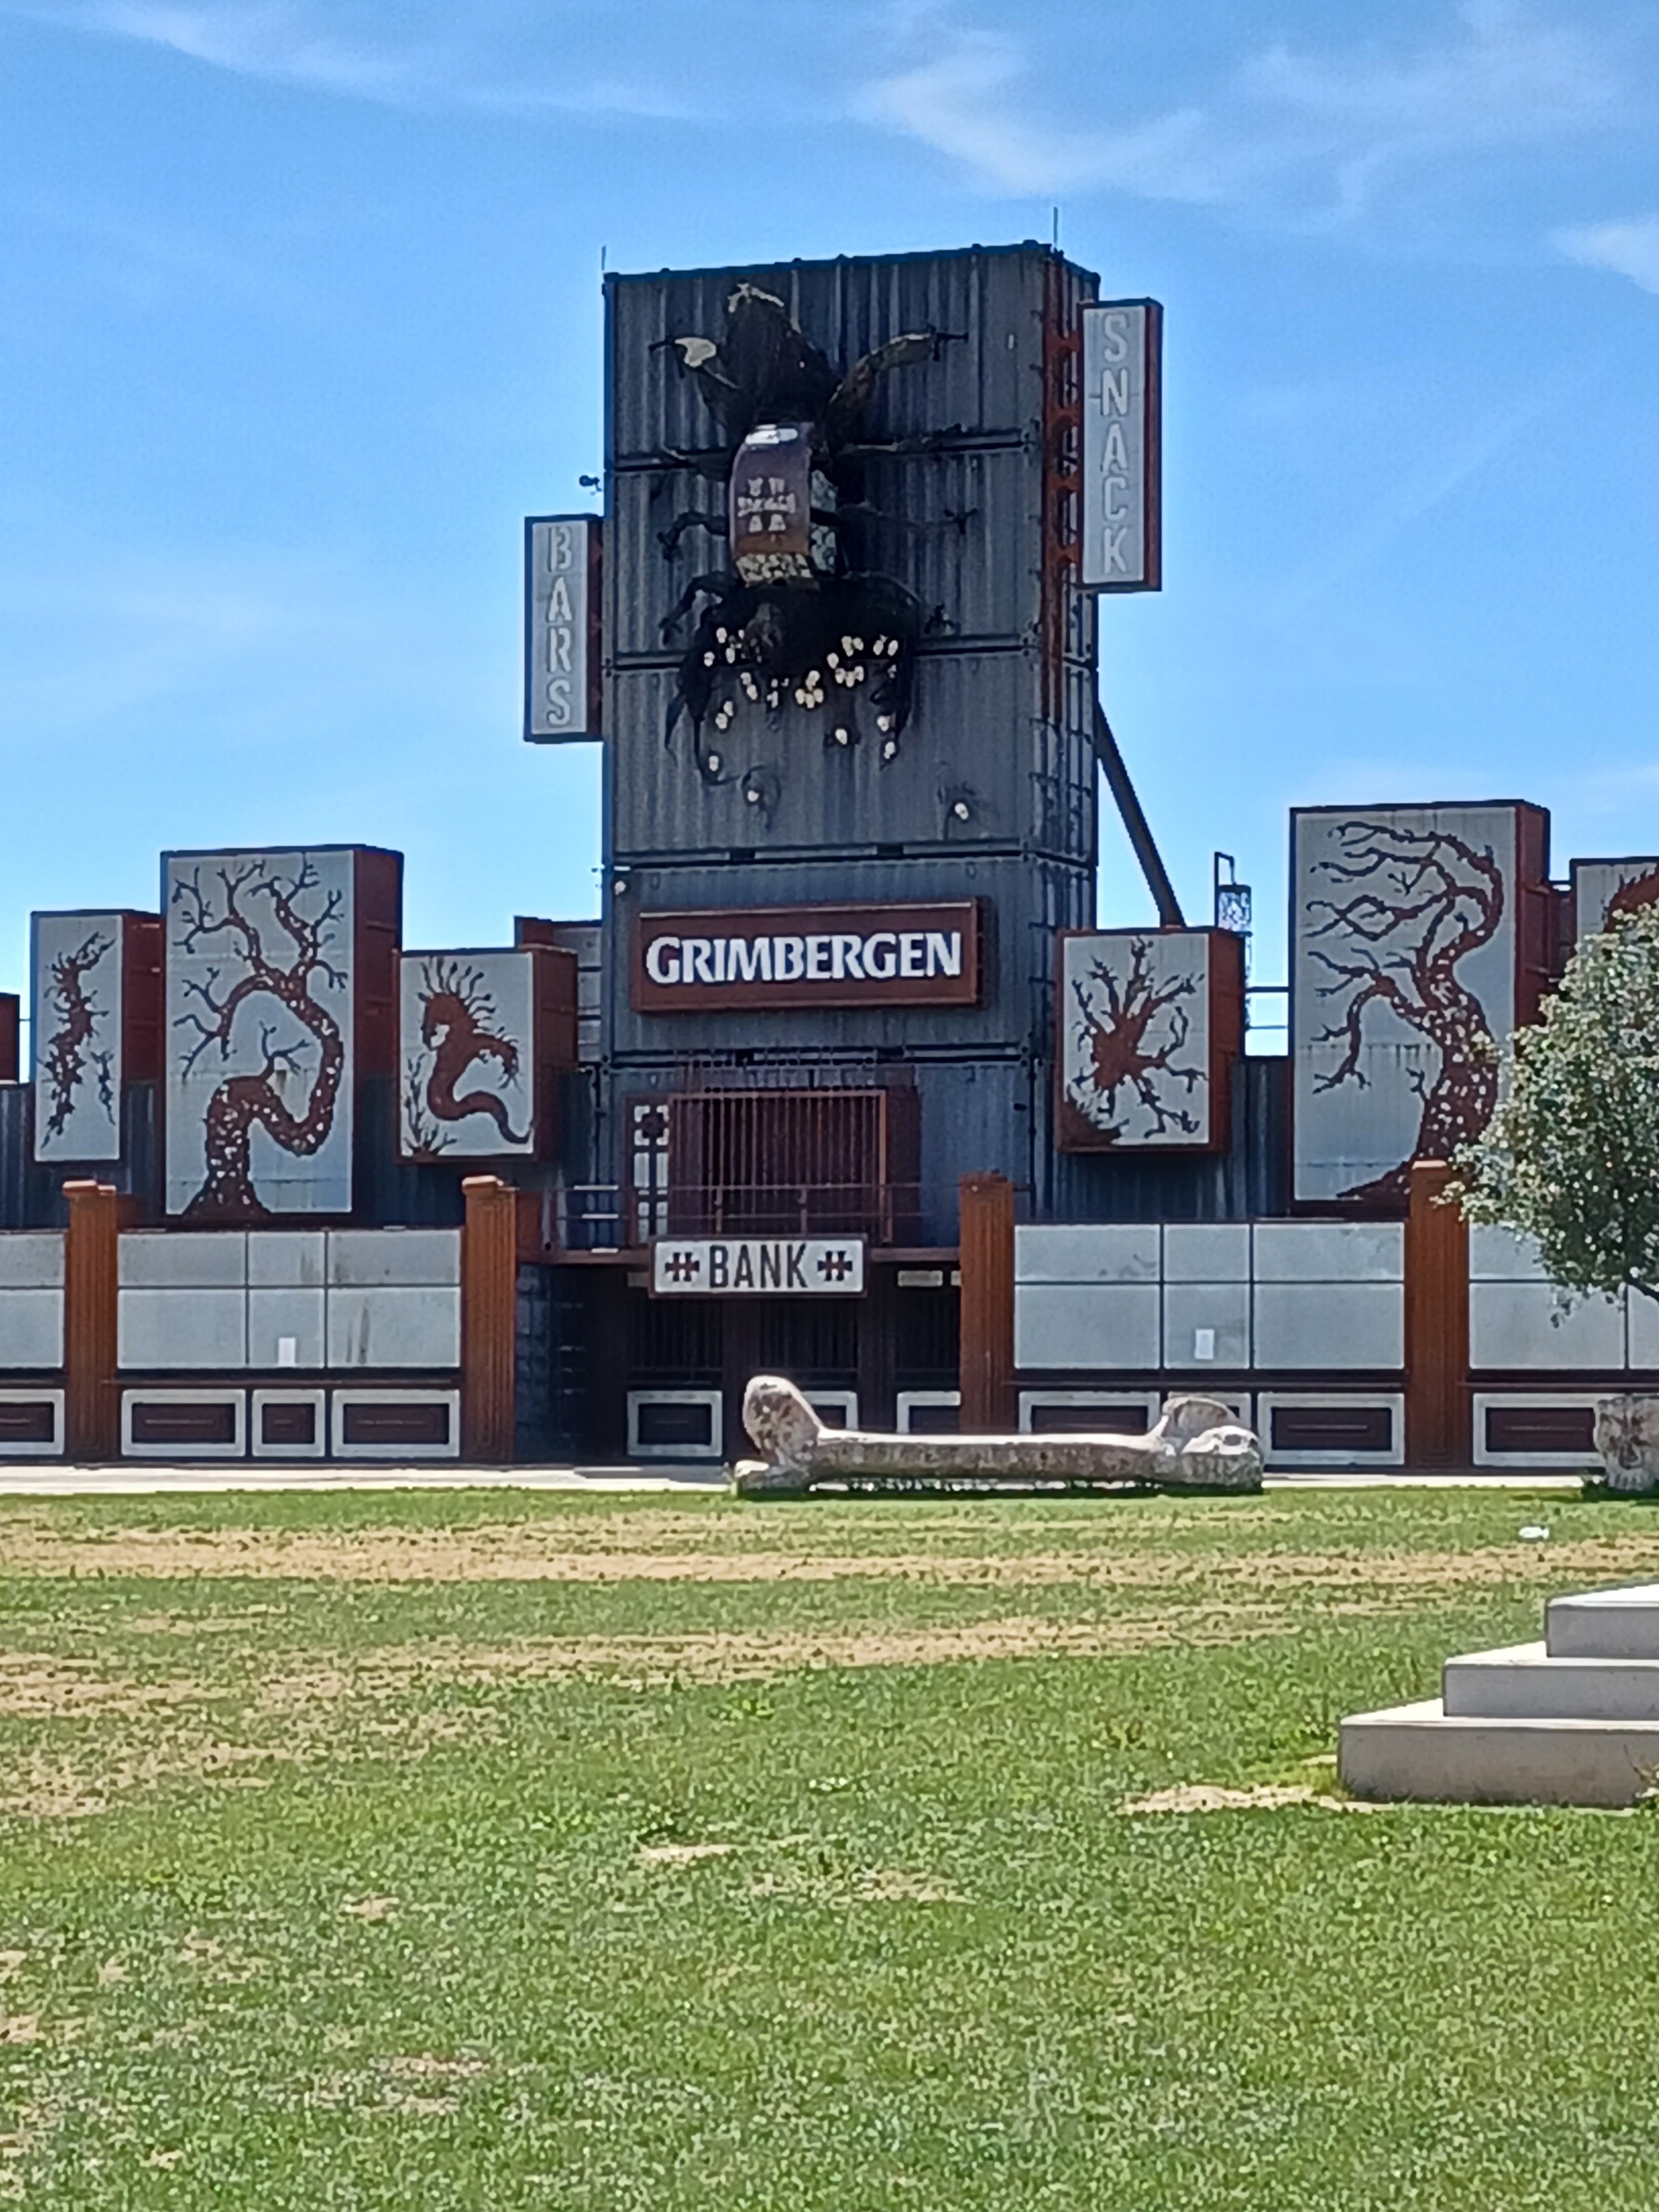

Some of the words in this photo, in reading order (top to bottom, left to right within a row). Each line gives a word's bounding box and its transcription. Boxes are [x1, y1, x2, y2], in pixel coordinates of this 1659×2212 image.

[1102, 314, 1128, 574] SNACK
[547, 526, 572, 726] BARS
[646, 932, 961, 984] GRIMBERGEN
[709, 1243, 808, 1288] BANK
